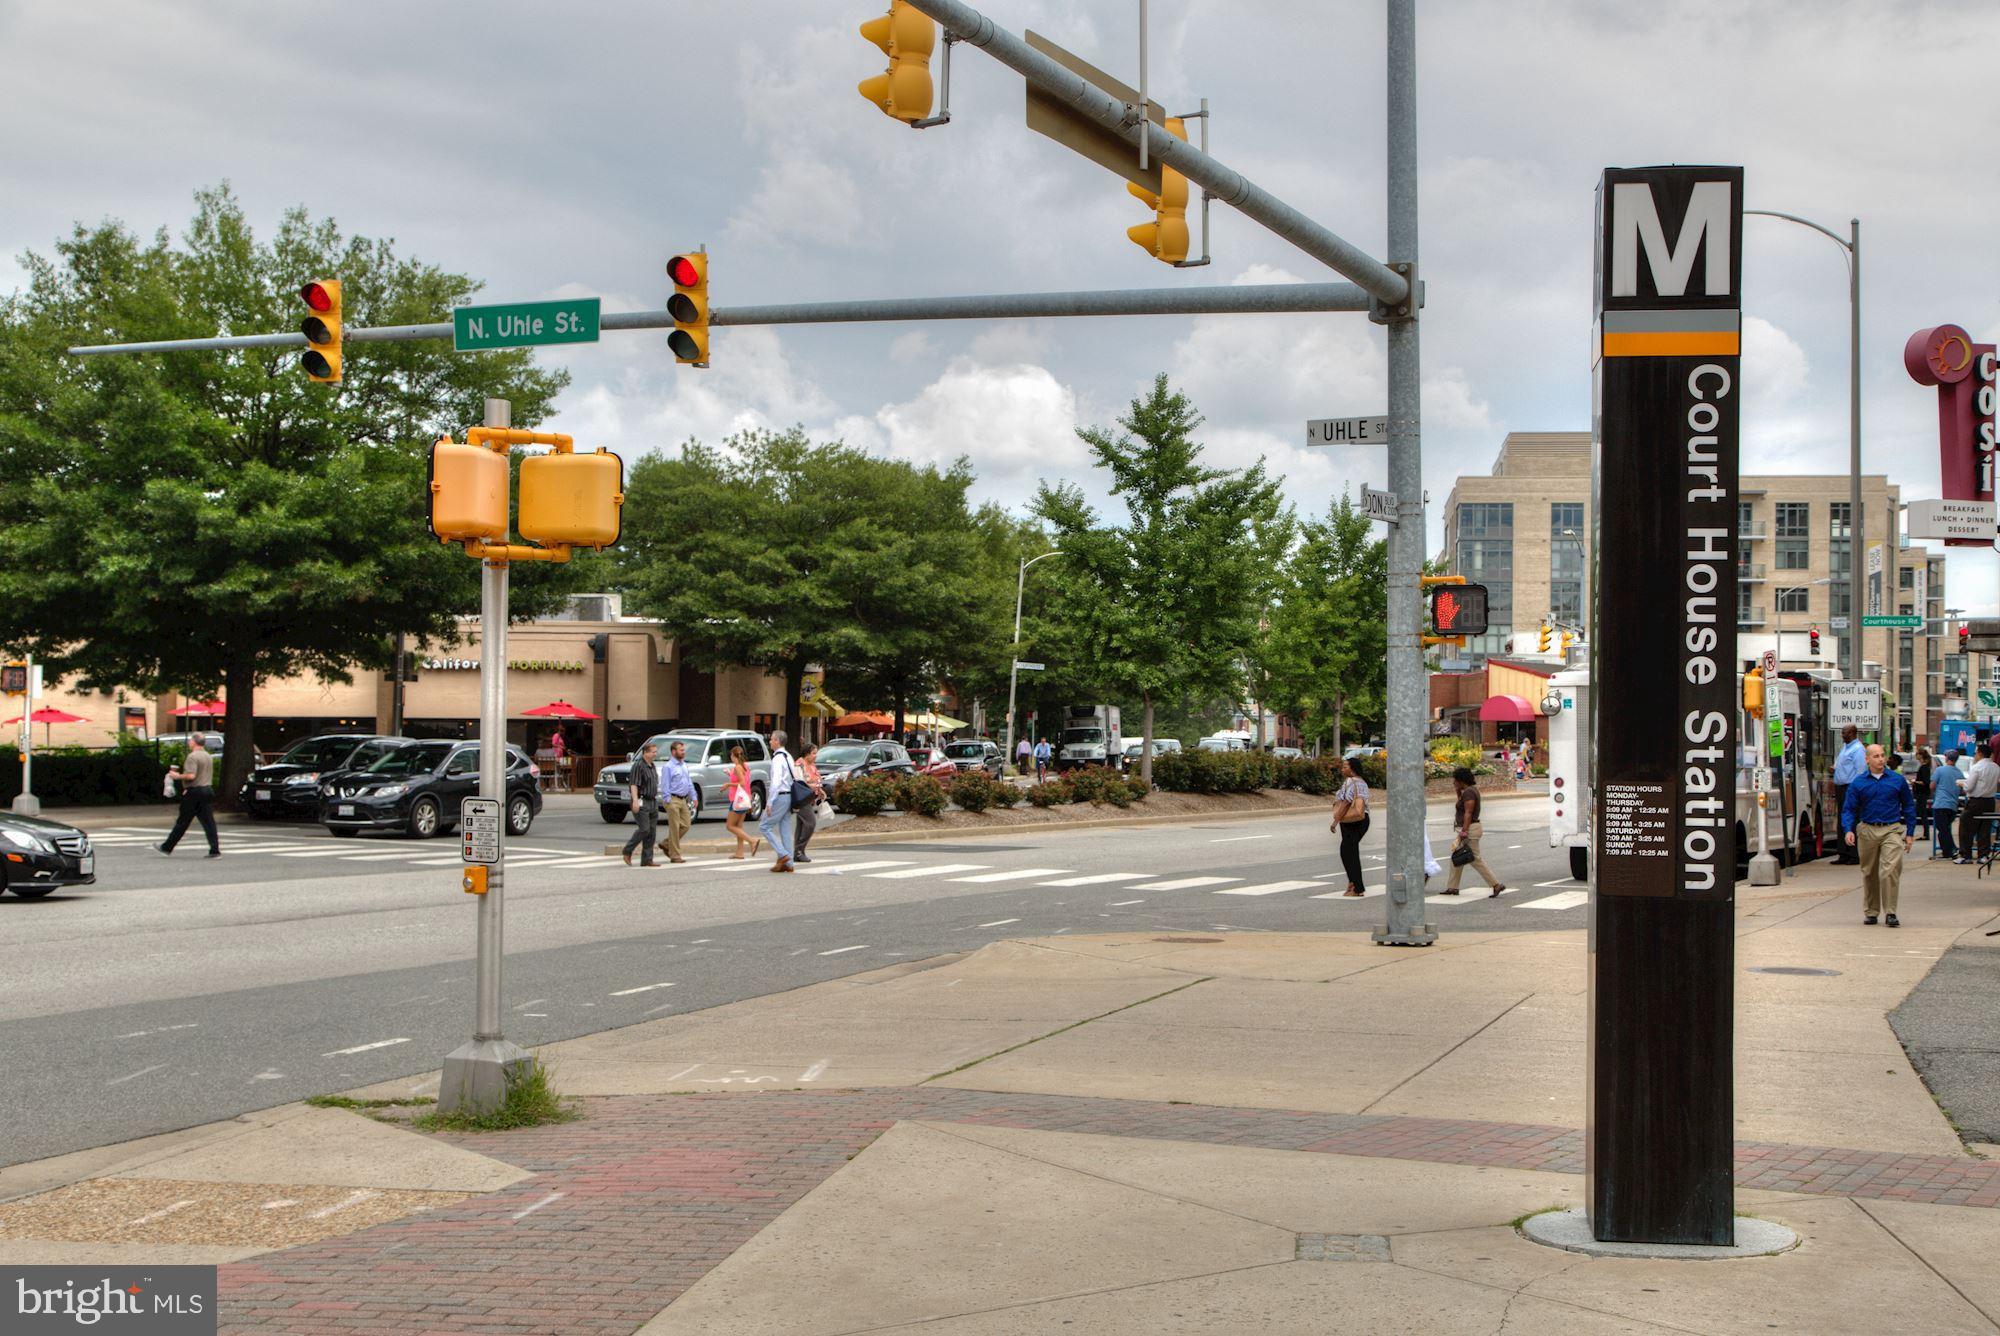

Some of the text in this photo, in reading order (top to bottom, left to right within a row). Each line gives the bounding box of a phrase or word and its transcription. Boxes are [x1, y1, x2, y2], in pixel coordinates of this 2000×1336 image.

[1611, 181, 1731, 297] M
[468, 311, 585, 339] N. Uhle St.
[1309, 428, 1315, 438] N
[1324, 420, 1368, 441] UHLE
[1943, 505, 1984, 513] BREAKFAST
[1967, 516, 1994, 524] DINNER
[1684, 363, 1731, 890] Court House Station
[421, 656, 584, 671] Califor TORTILLA
[1832, 686, 1877, 695] RIGHT LANE
[1841, 700, 1869, 710] MUST
[1832, 715, 1878, 724] TURN RIGHT
